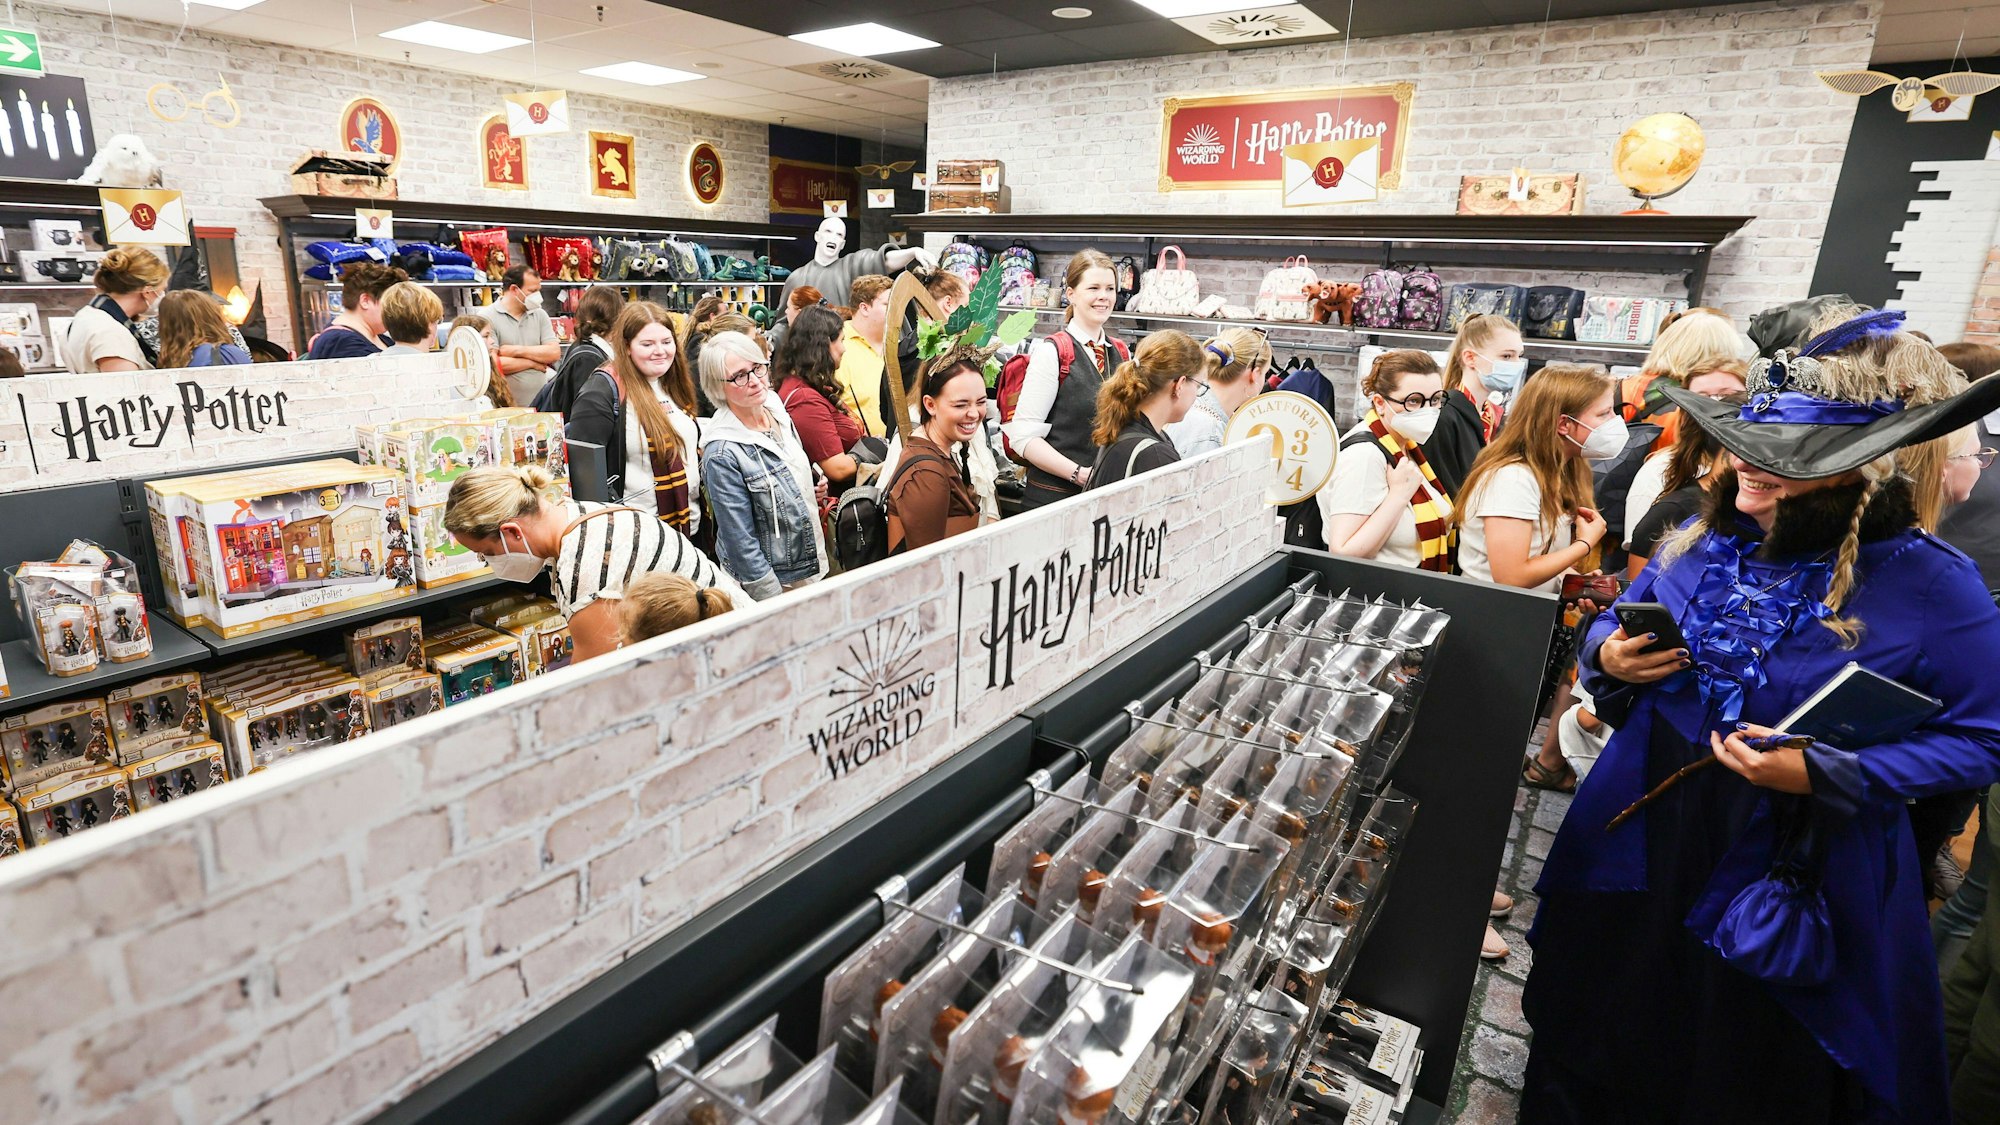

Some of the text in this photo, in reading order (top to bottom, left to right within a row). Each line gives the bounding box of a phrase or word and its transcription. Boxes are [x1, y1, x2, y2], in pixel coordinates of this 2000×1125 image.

[533, 106, 542, 118] H
[1176, 145, 1225, 155] WIZARDING
[1182, 154, 1220, 165] WORLD
[1322, 162, 1336, 179] H
[137, 207, 151, 222] H
[51, 380, 288, 462] Harry Potter
[1248, 401, 1319, 429] PLATFORM
[1291, 429, 1309, 456] 3
[1286, 466, 1303, 491] 4
[979, 515, 1167, 691] Harry Potter
[807, 672, 936, 756] WIZARDING
[826, 708, 923, 781] WORLD
